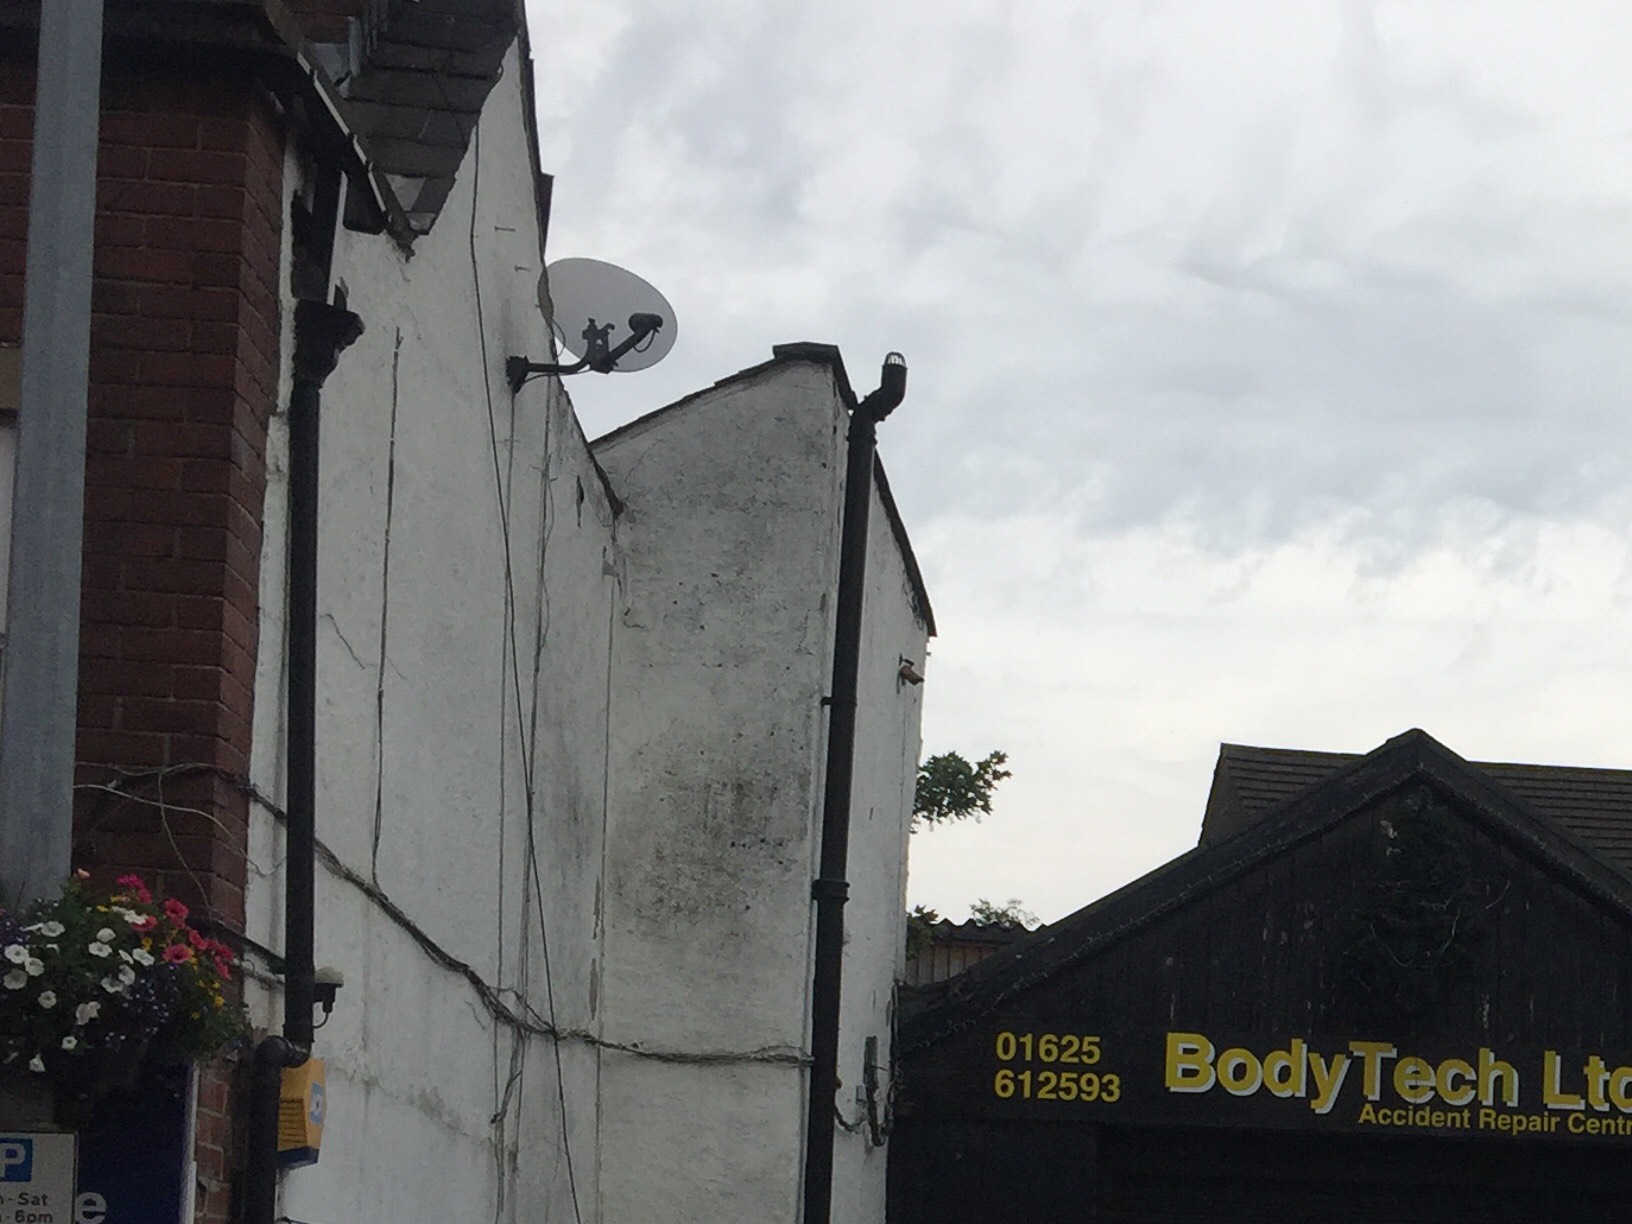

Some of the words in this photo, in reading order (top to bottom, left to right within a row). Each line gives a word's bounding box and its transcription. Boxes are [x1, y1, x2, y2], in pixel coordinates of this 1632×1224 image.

[995, 1030, 1101, 1065] 01625
[994, 1068, 1122, 1103] 612593
[1163, 1031, 1521, 1115] BodyTech
[1358, 1101, 1471, 1129] Accident
[1477, 1107, 1561, 1137] Repair
[17, 1192, 48, 1206] Sat
